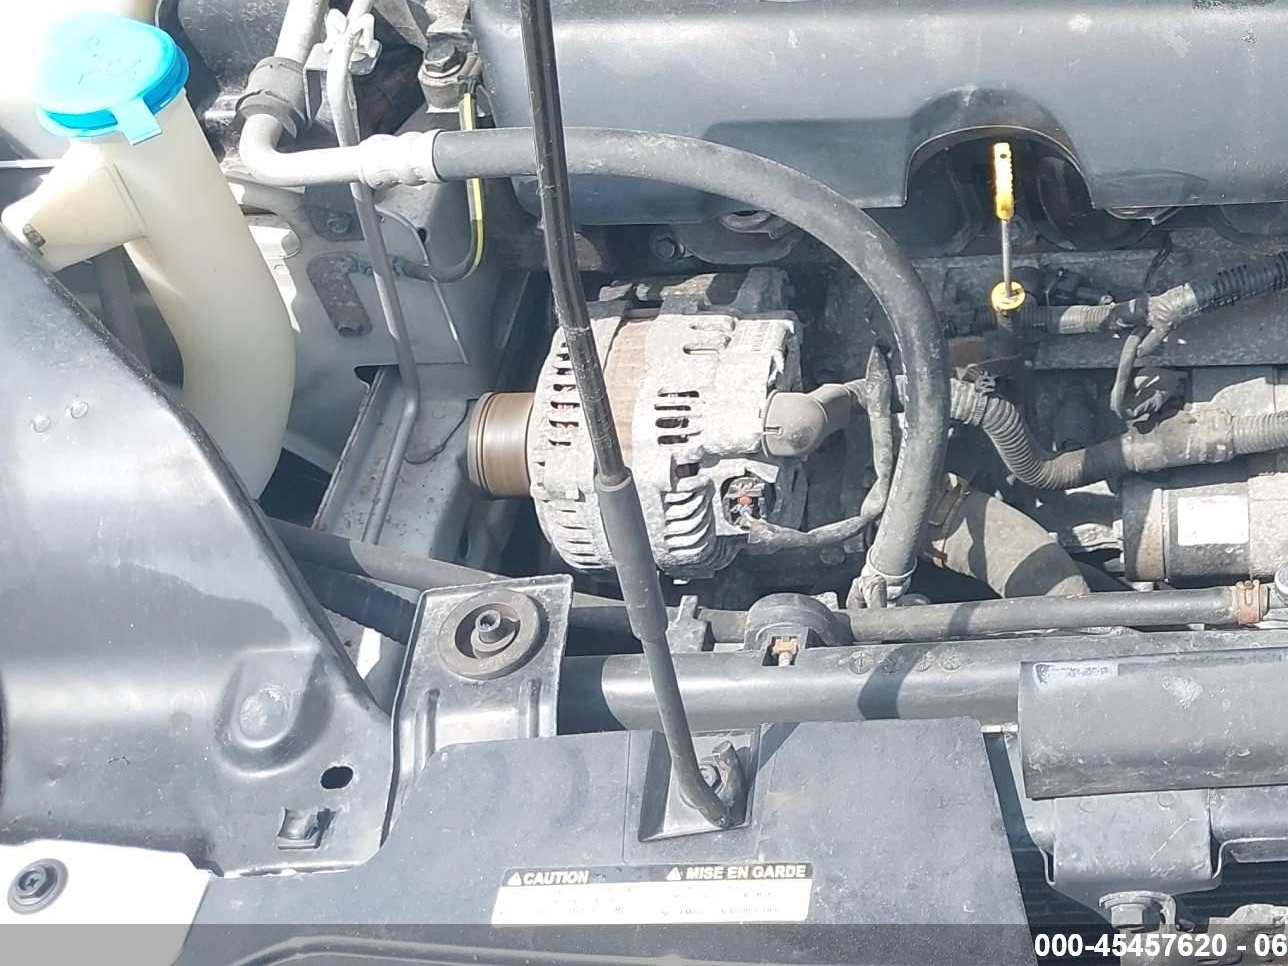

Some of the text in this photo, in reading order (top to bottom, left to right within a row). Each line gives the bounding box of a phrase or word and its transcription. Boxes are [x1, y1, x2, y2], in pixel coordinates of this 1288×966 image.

[523, 870, 590, 885] CAUTION
[686, 864, 807, 880] MISE EN GARDE
